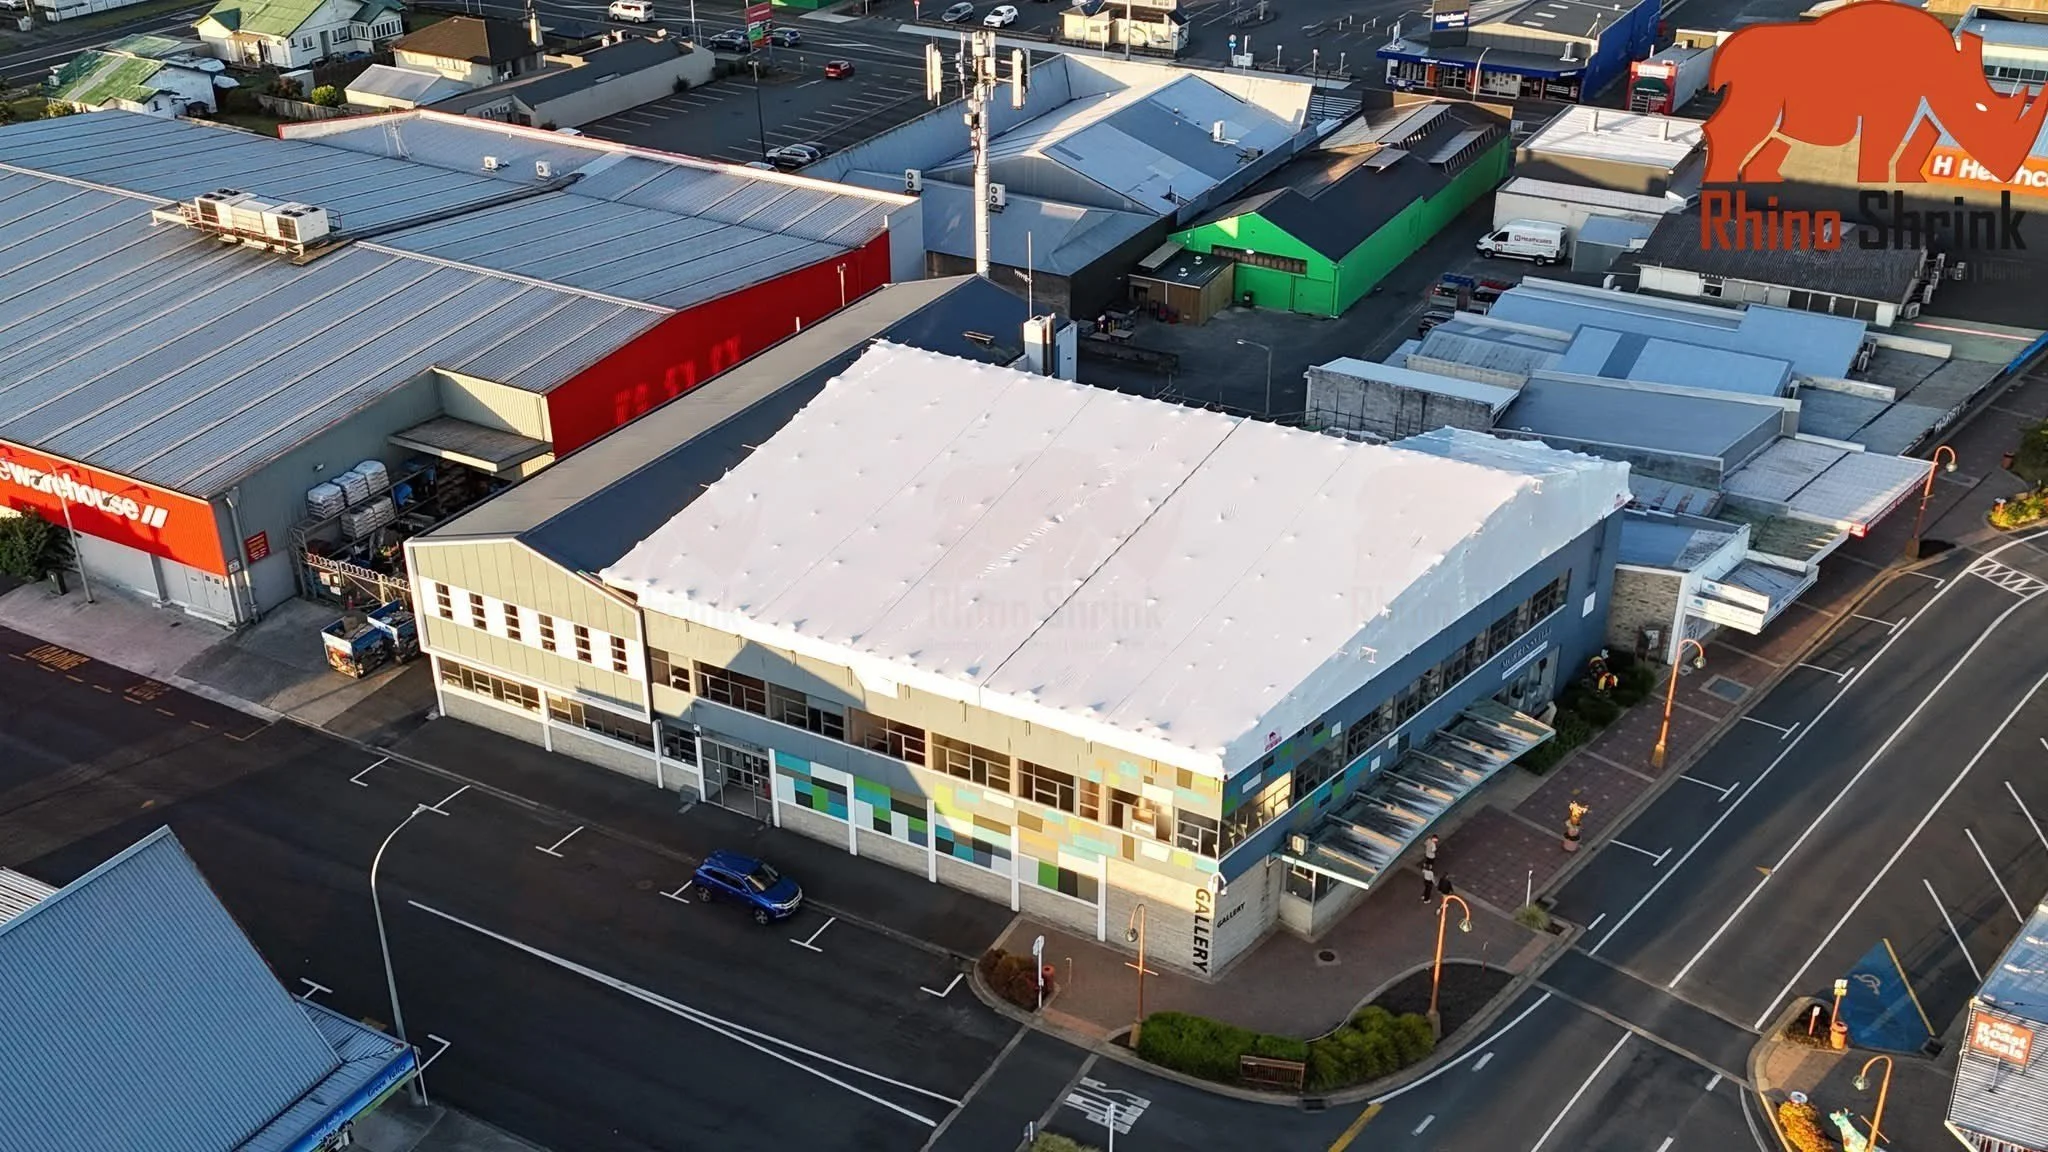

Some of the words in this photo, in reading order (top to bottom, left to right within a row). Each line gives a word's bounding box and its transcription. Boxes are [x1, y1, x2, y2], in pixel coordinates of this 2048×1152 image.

[1932, 154, 1954, 176] H
[1217, 902, 1246, 928] GALLERY
[1192, 888, 1211, 973] GALLERY
[1975, 1034, 2025, 1060] Meals
[1977, 1021, 2027, 1049] Roast
